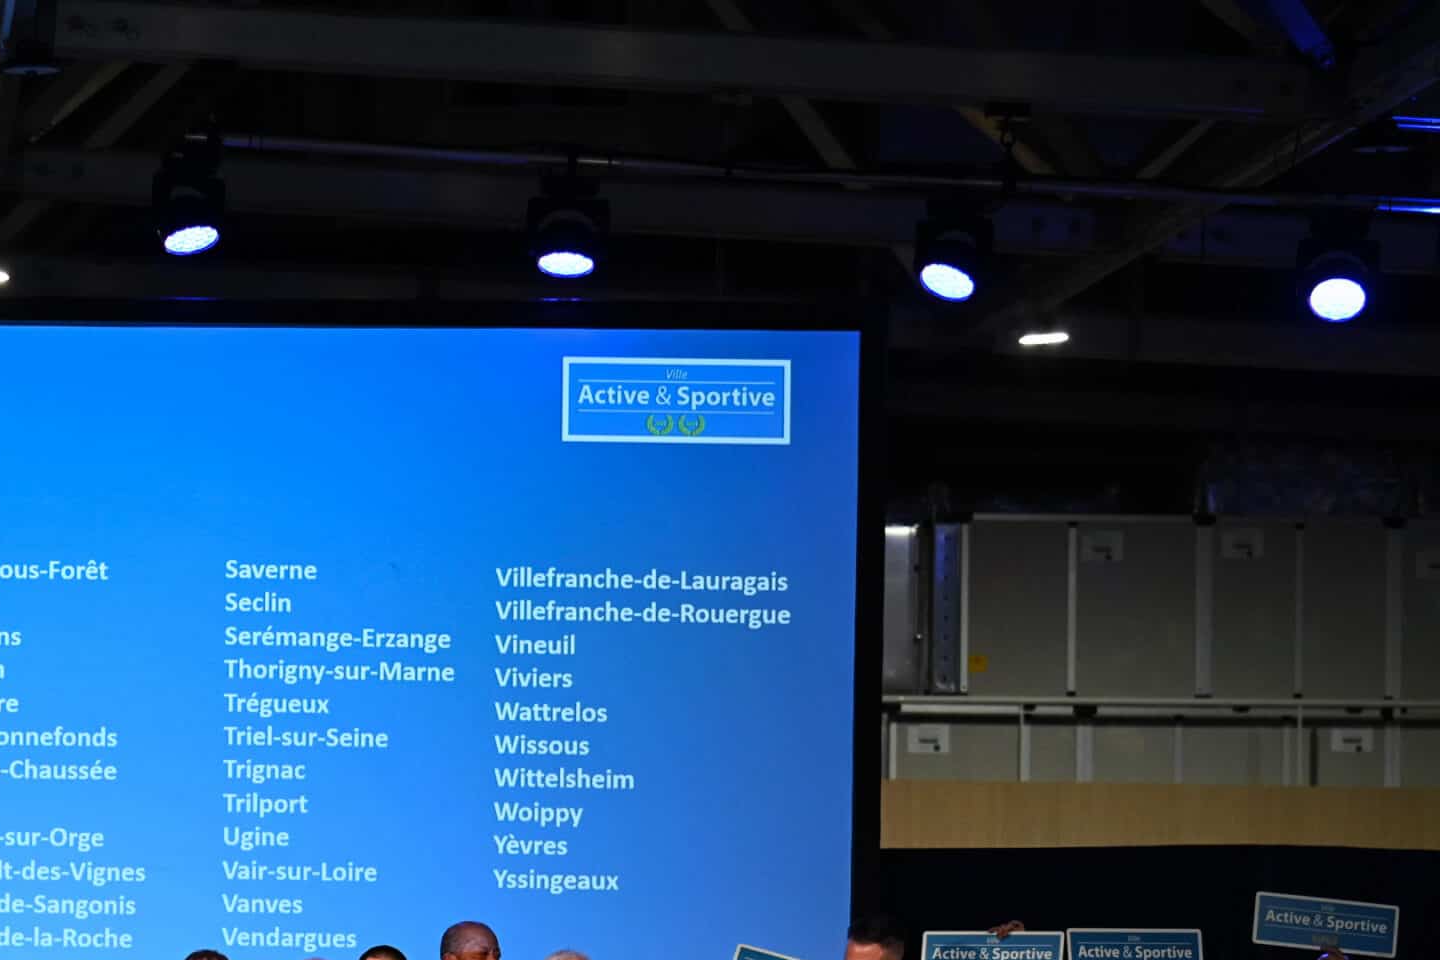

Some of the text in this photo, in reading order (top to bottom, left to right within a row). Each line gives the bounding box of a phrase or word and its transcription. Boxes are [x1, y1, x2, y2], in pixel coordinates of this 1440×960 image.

[665, 369, 688, 380] Ville
[578, 385, 775, 410] Active & Sportive
[225, 560, 317, 580] Saverne
[496, 566, 788, 596] Villefranche-de-Lauragais
[225, 592, 291, 613] Seclin
[496, 600, 791, 629] Villefranche-de-Rouergue
[225, 625, 451, 654] Serémange-Erzange
[495, 634, 575, 655] Vineuil
[224, 658, 455, 685] Thorigny-sur-Marne
[495, 667, 573, 688] Viviers
[224, 692, 328, 718] Trégueux
[495, 701, 607, 722] Wattrelos
[224, 725, 388, 748] Triel-sur-Seine
[495, 734, 589, 755] Wissous
[223, 759, 305, 784] Trignac
[495, 768, 634, 789] Wittelsheim
[223, 792, 308, 818] Trilport
[494, 802, 583, 827] Woippy
[224, 827, 289, 851] Ugine
[494, 834, 568, 855] Yèvres
[223, 860, 377, 881] Vair-sur-Loire
[493, 869, 618, 894] Yssingeaux
[222, 894, 303, 913] Vanves
[1265, 910, 1387, 934] Active & Sportive
[222, 927, 356, 952] Vendargues
[932, 947, 976, 960] Active
[980, 948, 989, 960] &
[1078, 945, 1192, 960] Active & Sportive
